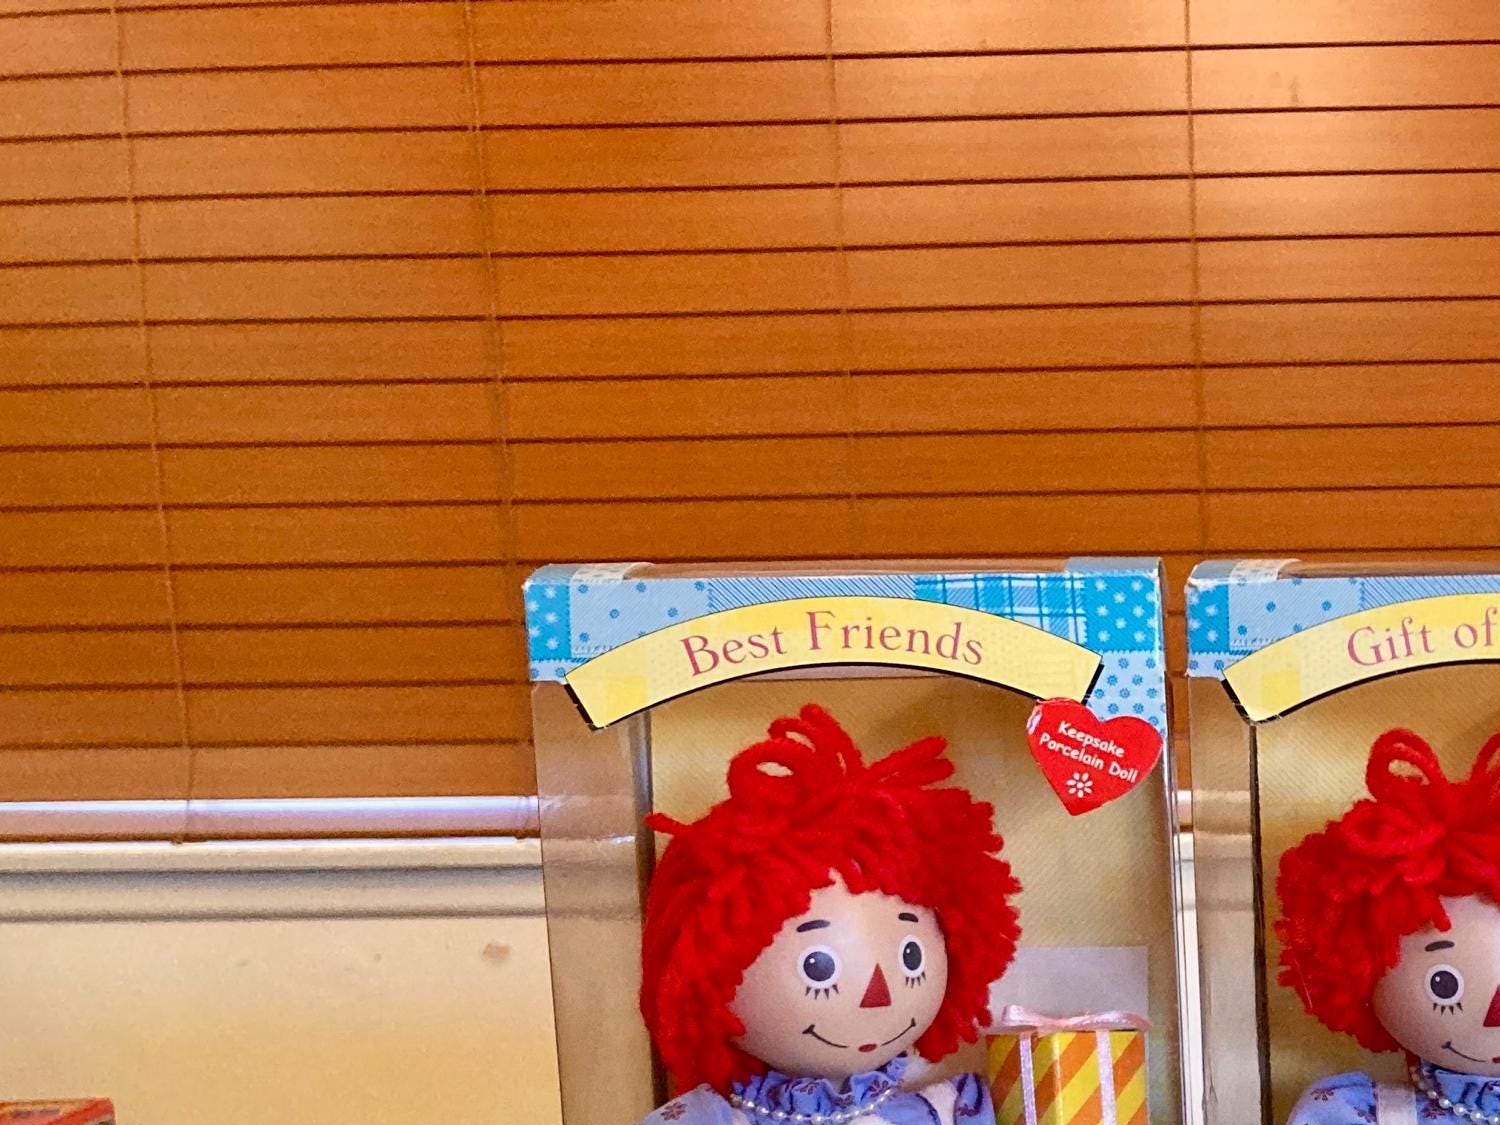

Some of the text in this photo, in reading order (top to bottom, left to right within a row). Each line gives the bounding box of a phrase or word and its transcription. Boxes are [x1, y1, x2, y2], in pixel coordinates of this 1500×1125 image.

[680, 610, 983, 677] Best Friends
[1347, 616, 1435, 667] Gift
[1453, 607, 1498, 649] of
[1039, 732, 1138, 783] Porcelain Doll
[1058, 720, 1125, 758] Keepsake
